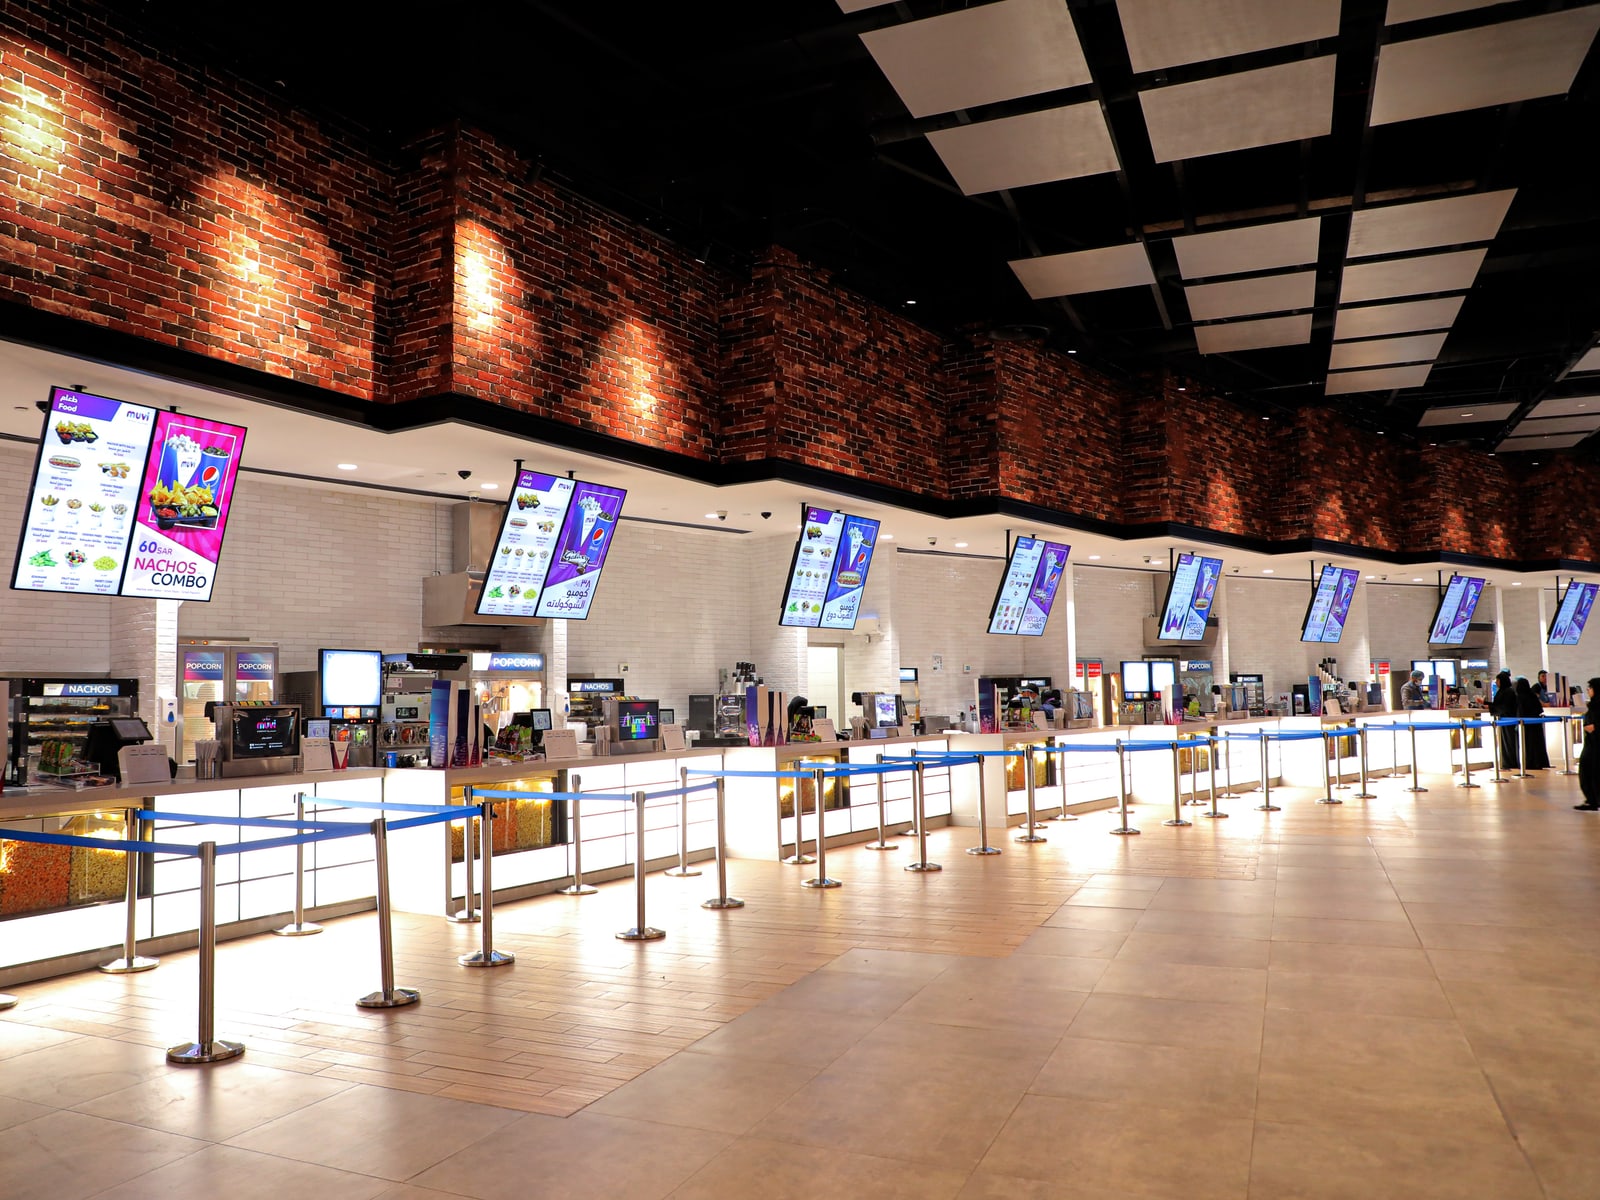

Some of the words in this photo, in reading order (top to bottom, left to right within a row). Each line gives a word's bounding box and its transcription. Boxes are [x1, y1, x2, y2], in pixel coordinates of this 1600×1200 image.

[58, 403, 78, 412] Food
[126, 410, 151, 421] muvi
[139, 540, 158, 554] 60
[156, 547, 173, 555] SAR
[134, 557, 197, 575] NACHOS
[151, 572, 207, 588] COMBO
[493, 658, 541, 667] POPCORN
[69, 685, 112, 693] NACHOS
[256, 719, 277, 729] muvi
